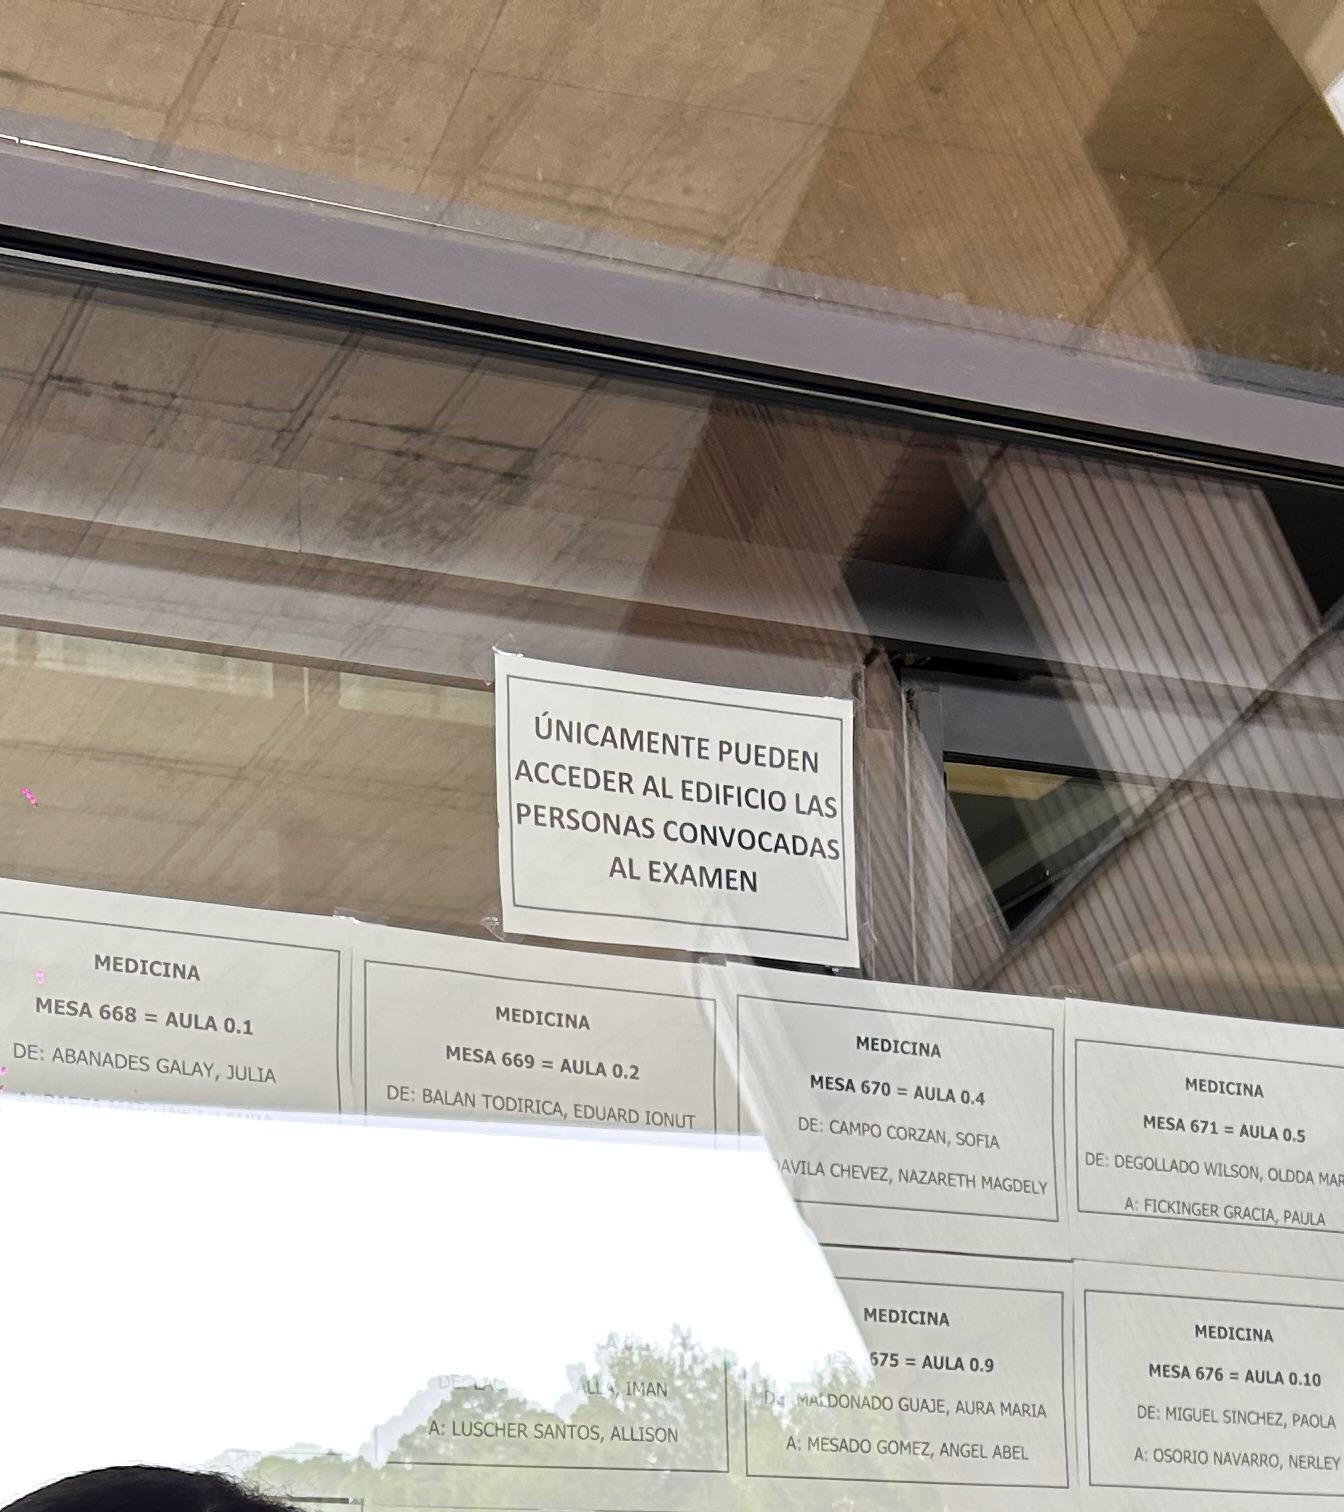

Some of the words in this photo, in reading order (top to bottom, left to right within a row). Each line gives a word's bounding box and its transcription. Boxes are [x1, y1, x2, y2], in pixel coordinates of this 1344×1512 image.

[535, 711, 710, 760] ÚNICAMENTE
[719, 740, 818, 773] PUEDEN
[515, 759, 634, 795] ACCEDER
[642, 775, 673, 799] AL
[681, 779, 786, 812] EDIFICIO
[795, 792, 838, 817] LAS
[517, 803, 655, 839] PERSONAS
[663, 820, 840, 860] CONVOCADAS
[609, 856, 641, 880] AL
[649, 860, 757, 893] EXAMEN
[95, 954, 200, 981] MEDICINA
[36, 997, 93, 1019] MESA
[99, 1004, 137, 1023] 668
[145, 1013, 157, 1023] =
[165, 1011, 218, 1032] AULA
[224, 1017, 253, 1035] 0.1
[496, 1006, 590, 1030] MEDICINA
[856, 1036, 941, 1058] MEDICINA
[13, 1042, 44, 1061] DE:
[52, 1047, 150, 1072] ABANADES
[156, 1058, 220, 1082] GALAY,
[226, 1064, 277, 1084] JULIA
[1185, 1077, 1264, 1098] MEDICINA
[1143, 1115, 1186, 1132] MESA
[1190, 1119, 1218, 1135] 671
[1224, 1126, 1234, 1134] =
[1239, 1124, 1279, 1141] AULA
[1283, 1128, 1305, 1143] 0.5
[1085, 1151, 1109, 1167] DE:
[1114, 1154, 1200, 1175] DEGOLLADO
[1204, 1161, 1263, 1183] WILSON,
[1268, 1167, 1315, 1185] OLDDA
[1124, 1197, 1138, 1211] A:
[1144, 1198, 1220, 1218] FICKINGER
[1223, 1204, 1279, 1226] GRACIA,
[1283, 1209, 1326, 1226] PAULA
[864, 1307, 950, 1327] MEDICINA
[1195, 1324, 1274, 1343] MEDICINA
[1149, 1363, 1191, 1379] MESA
[1195, 1366, 1224, 1382] 676
[1229, 1372, 1239, 1380] =
[1245, 1369, 1284, 1385] AULA
[1289, 1372, 1321, 1387] 0.10
[1137, 1404, 1160, 1420] DE:
[1165, 1406, 1219, 1423] MIGUEL
[1222, 1409, 1287, 1430] SINCHEZ,
[1292, 1413, 1336, 1429] PAOLA
[1134, 1447, 1148, 1462] A:
[1153, 1448, 1209, 1465] OSORIO
[1213, 1451, 1283, 1471] NAVARRO,
[1289, 1454, 1341, 1470] NERLEY
